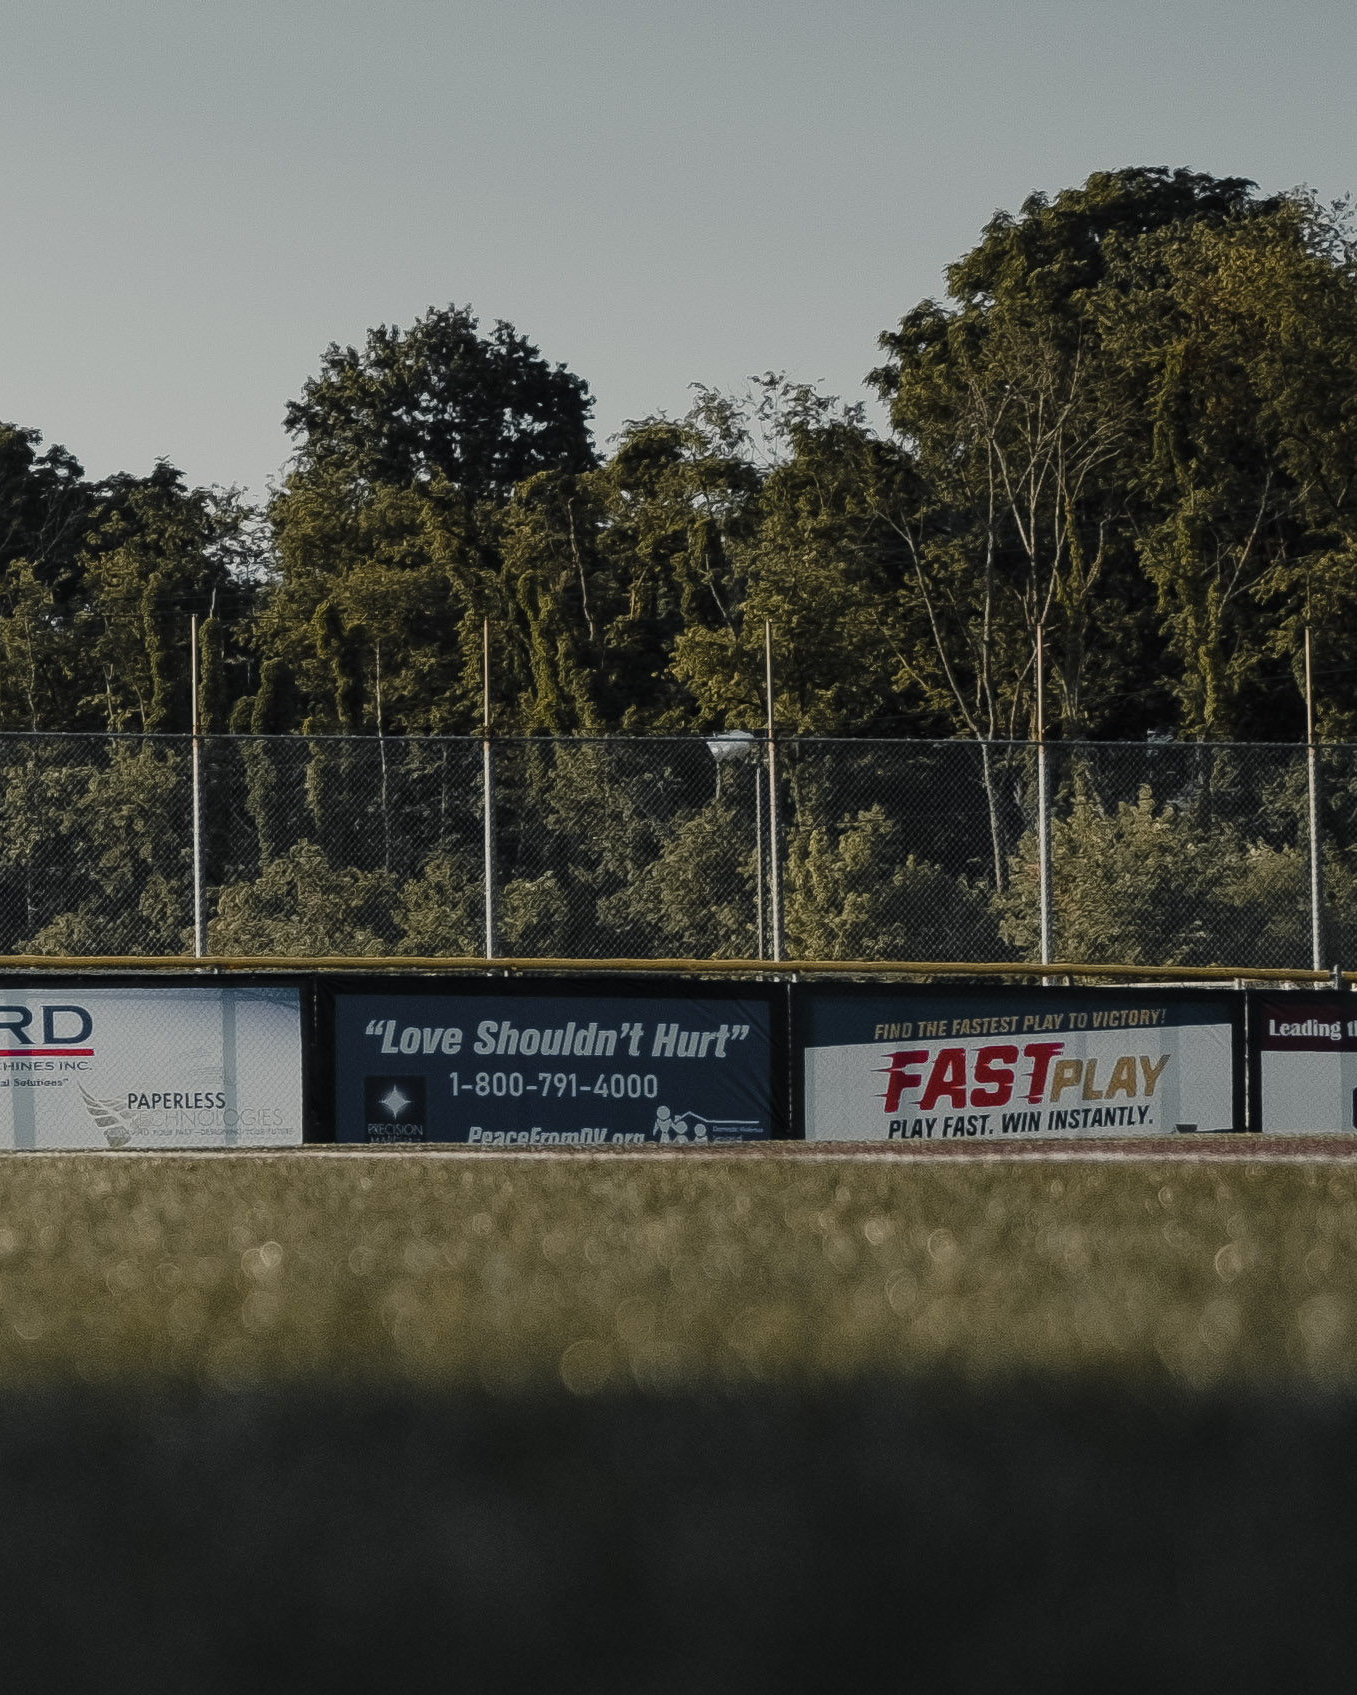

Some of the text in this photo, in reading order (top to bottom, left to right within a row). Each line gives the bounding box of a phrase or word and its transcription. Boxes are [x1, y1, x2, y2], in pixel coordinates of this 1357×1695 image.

[874, 1008, 1167, 1041] FIND THE FASTEST PLAY TO VICTORY!
[1268, 1019, 1342, 1041] Leading
[365, 1019, 751, 1058] “Love Shouldn’t Hurt”
[59, 1060, 94, 1072] INC.
[871, 1042, 1172, 1113] FAST PLAY
[449, 1071, 658, 1098] 1-800-791-4000
[127, 1092, 226, 1110] PAPERLESS
[138, 1108, 285, 1127] ECHNOLOGIES
[888, 1104, 1154, 1140] PLAY FAST. WIN INSTANTLY.
[467, 1126, 646, 1146] PeaceFromDVorg
